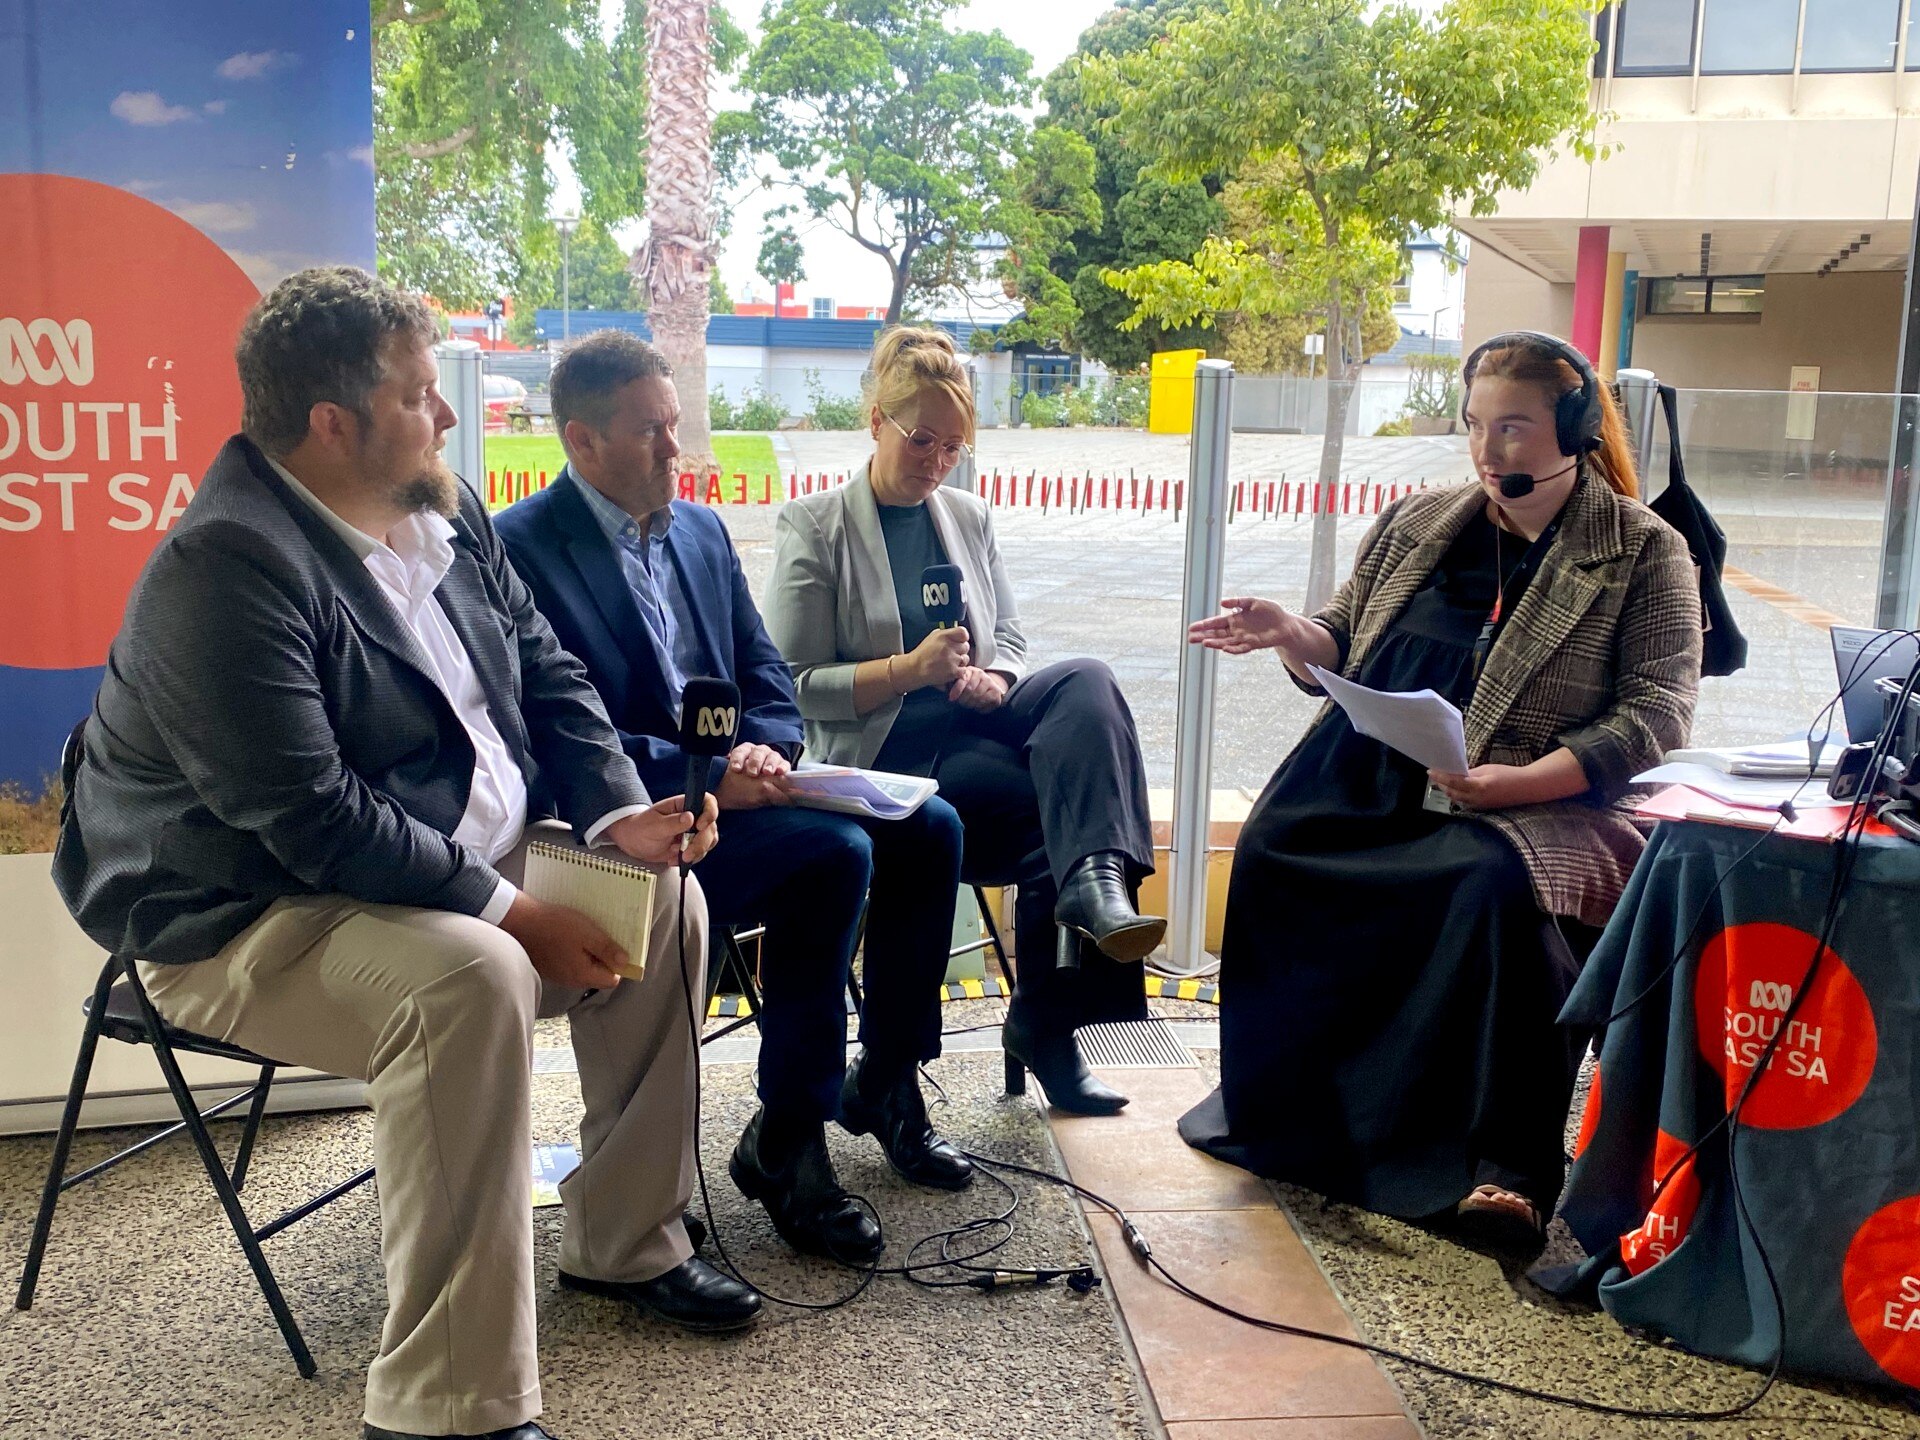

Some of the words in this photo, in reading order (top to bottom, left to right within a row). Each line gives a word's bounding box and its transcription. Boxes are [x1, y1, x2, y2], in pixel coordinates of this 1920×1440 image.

[0, 472, 89, 532] ST
[108, 472, 196, 531] SA
[1785, 1050, 1829, 1085] SA
[1883, 1300, 1920, 1332] EA
